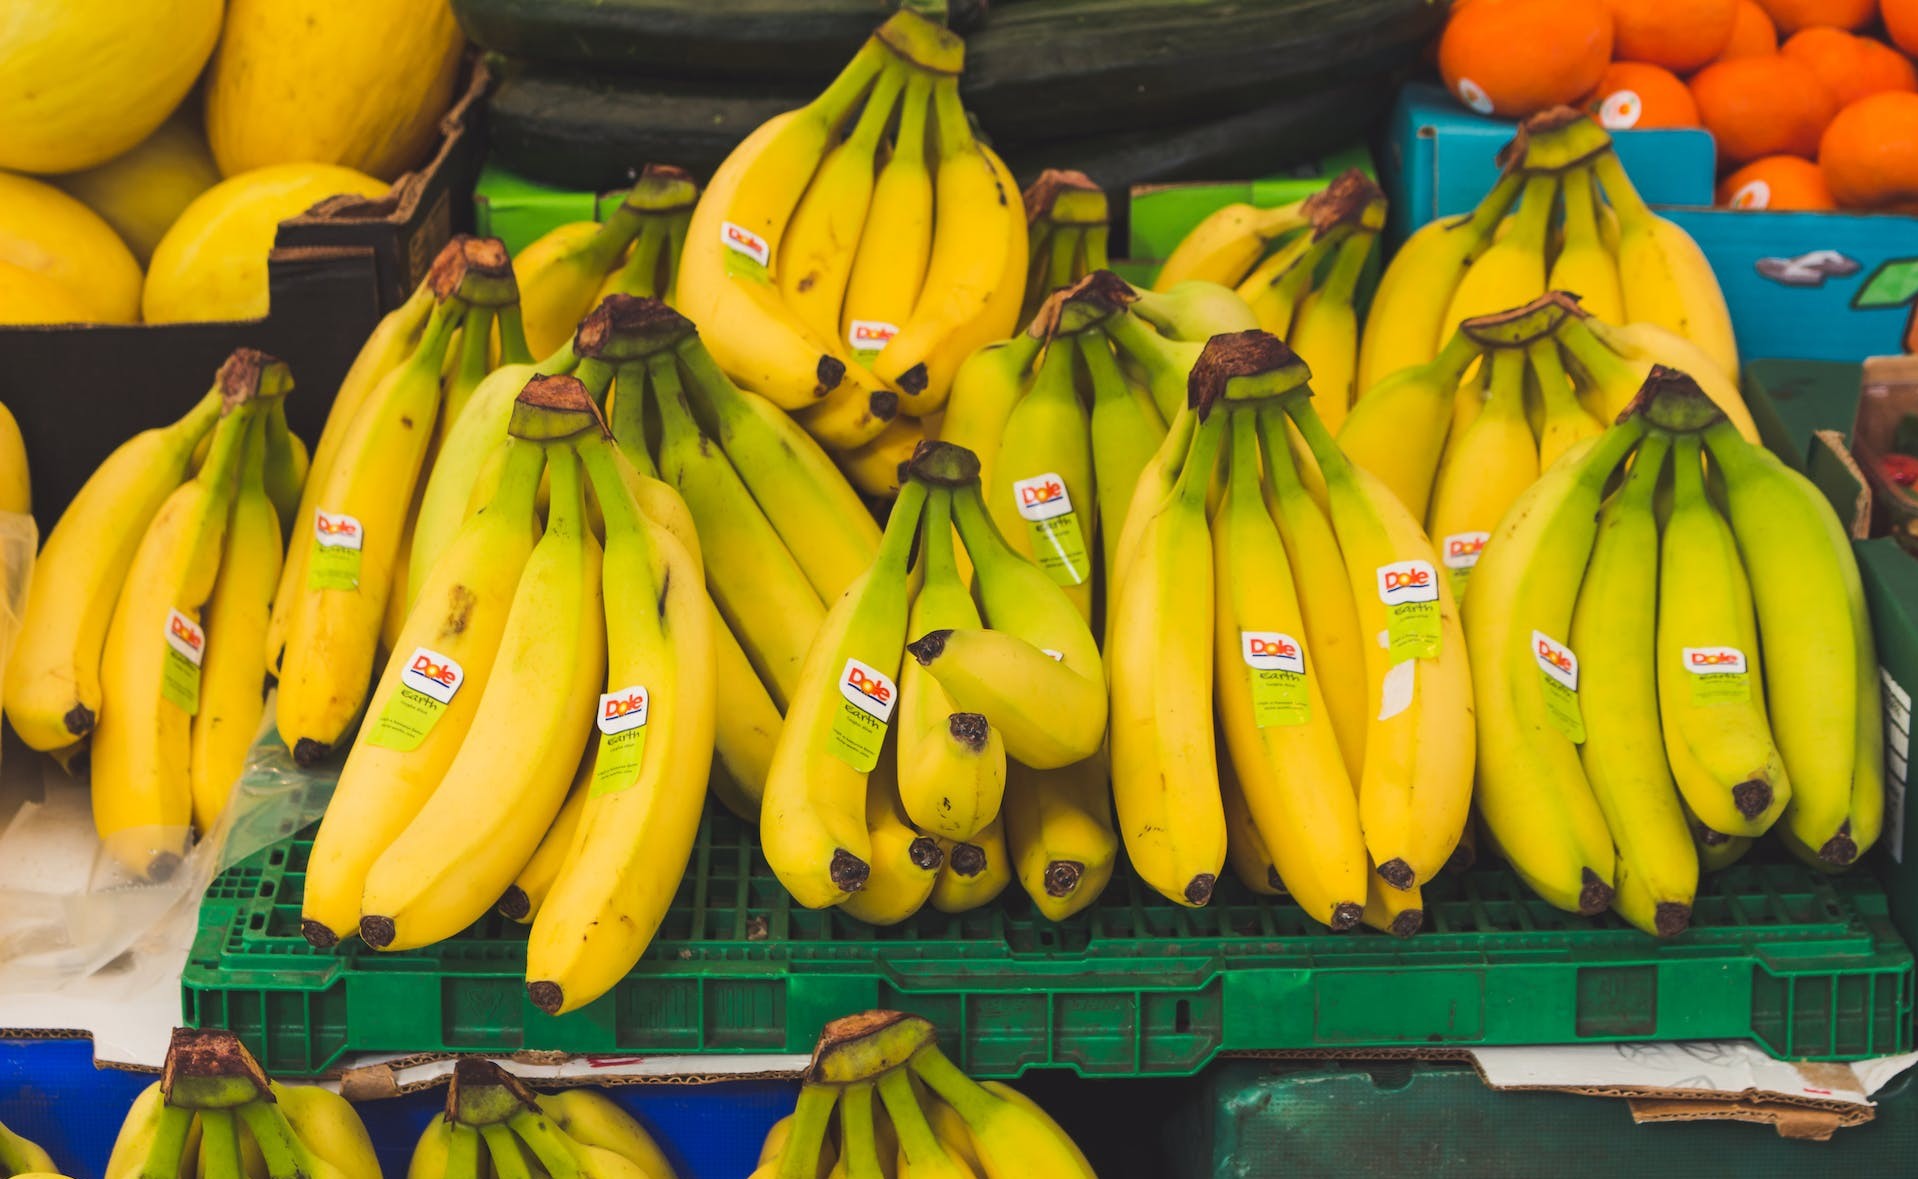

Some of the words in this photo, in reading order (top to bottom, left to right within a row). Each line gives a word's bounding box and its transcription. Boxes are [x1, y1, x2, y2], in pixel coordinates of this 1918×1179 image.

[1022, 481, 1062, 504] Dole
[318, 514, 356, 535] Dole
[1385, 567, 1428, 589] Dole
[171, 616, 202, 650] Dole
[1250, 639, 1296, 656] Dole
[1539, 640, 1572, 671] Dole
[1692, 652, 1738, 664] Dole
[413, 655, 456, 684] Dole
[848, 667, 891, 702] Dole
[605, 693, 643, 717] Dole
